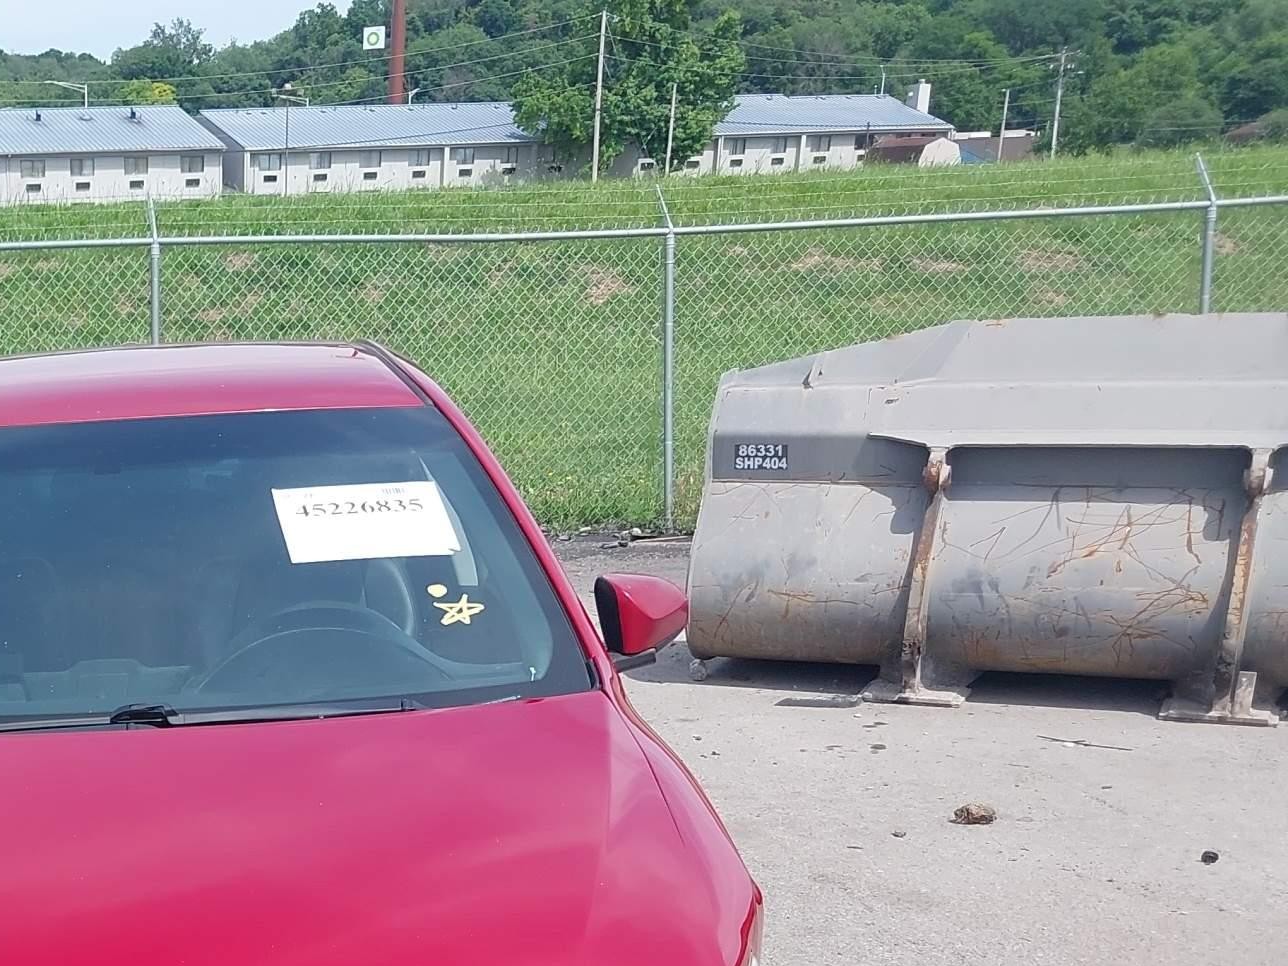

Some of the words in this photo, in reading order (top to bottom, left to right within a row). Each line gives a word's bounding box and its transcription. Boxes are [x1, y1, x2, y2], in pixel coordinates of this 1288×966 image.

[738, 444, 783, 457] 86331
[735, 457, 787, 470] SHP404
[295, 498, 424, 517] 45226835
